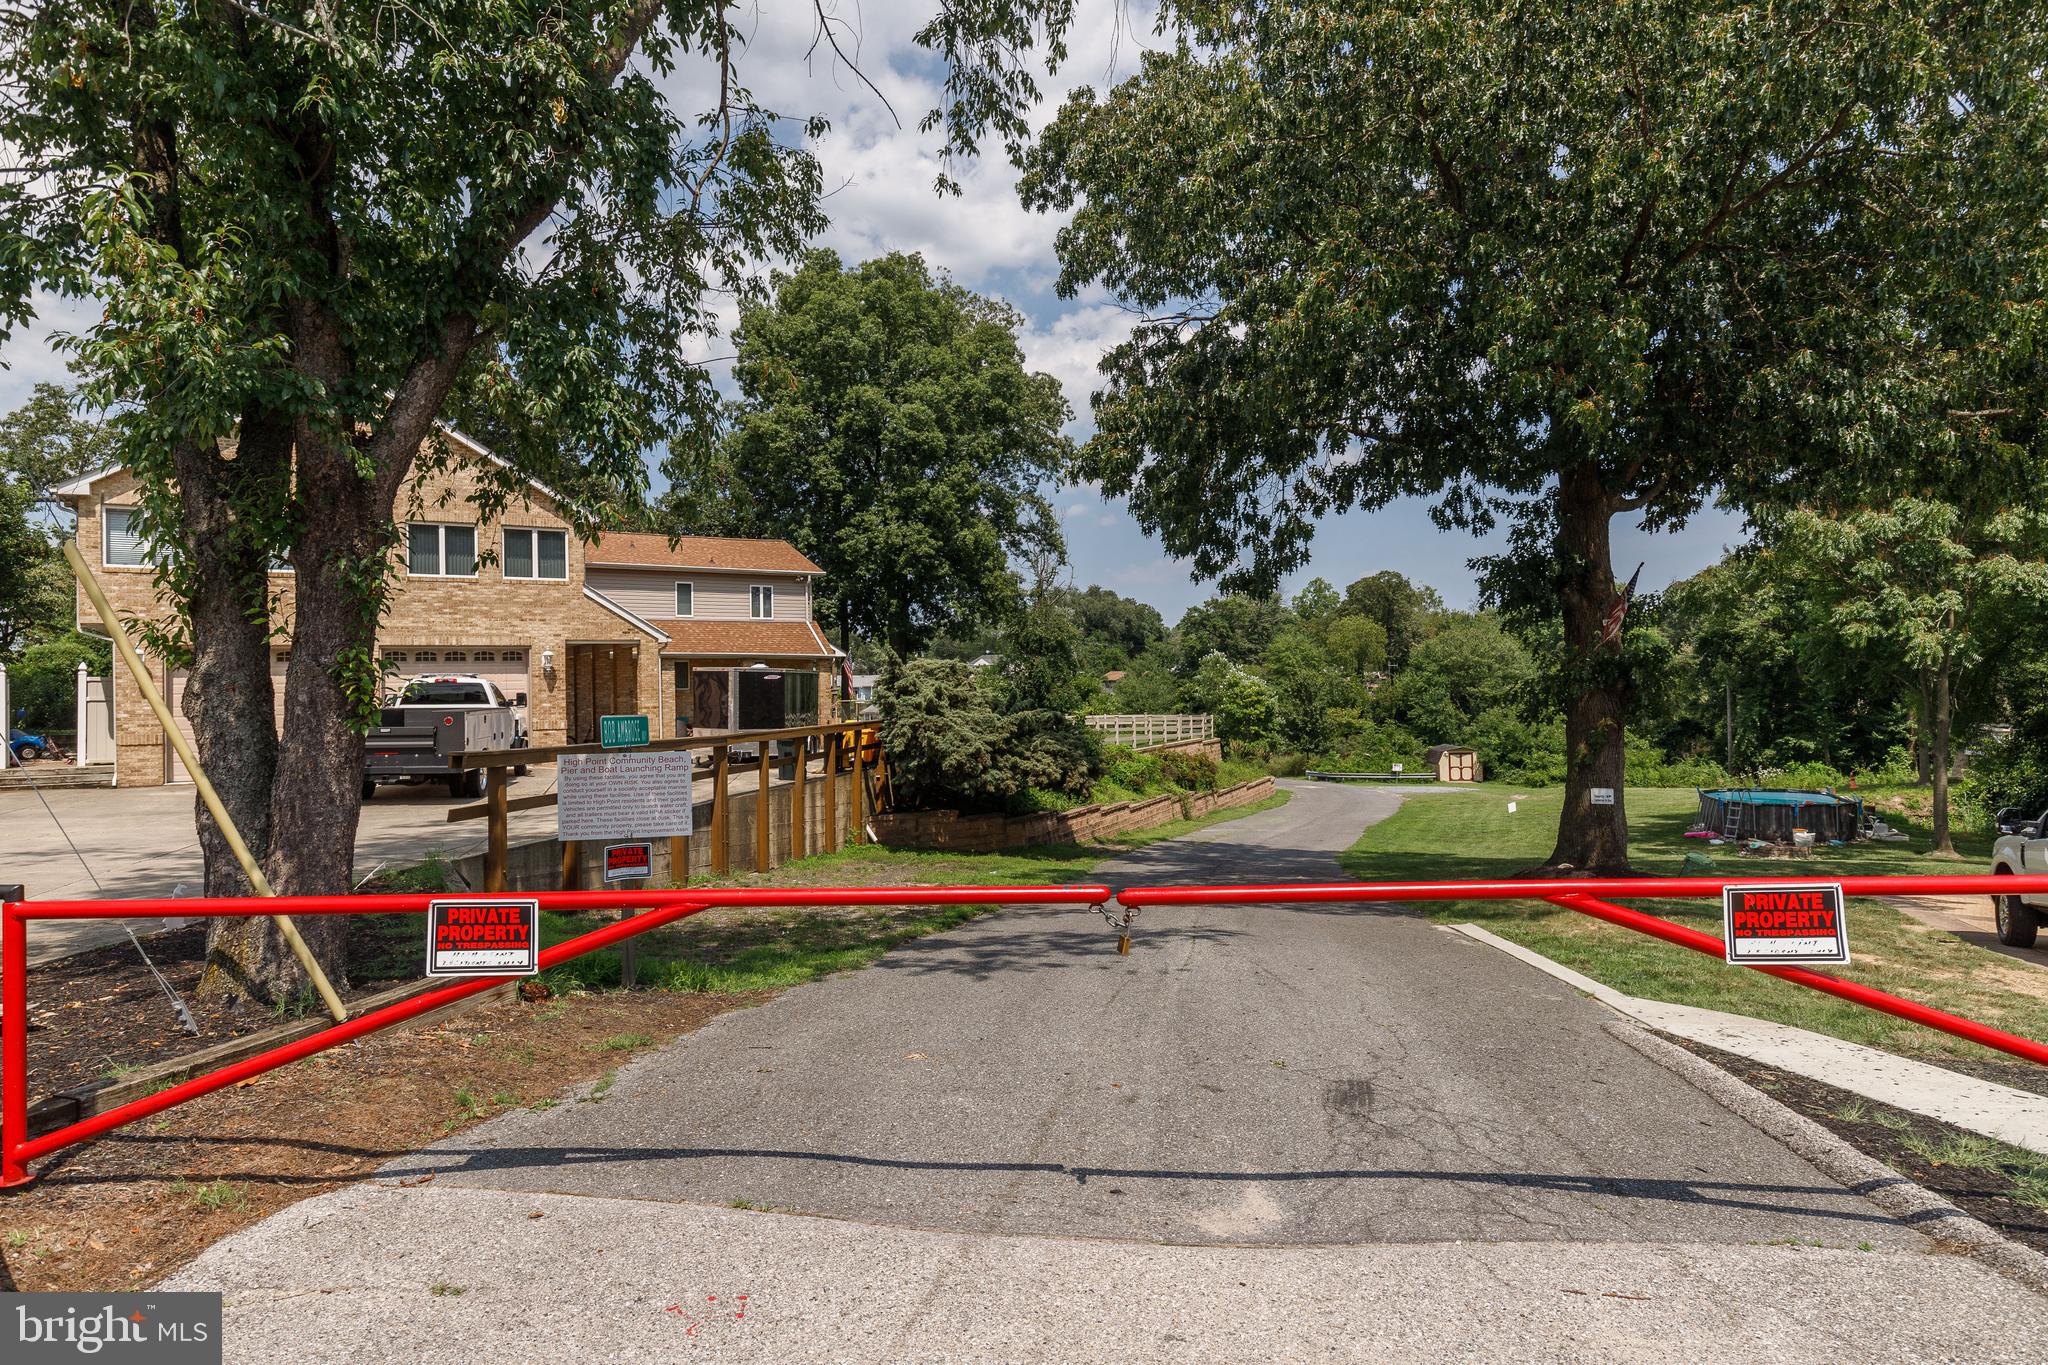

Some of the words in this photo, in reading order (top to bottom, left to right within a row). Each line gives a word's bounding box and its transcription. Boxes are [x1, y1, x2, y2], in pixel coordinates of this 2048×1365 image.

[604, 720, 616, 743] BOB
[618, 720, 640, 742] AMBROSE
[564, 758, 583, 767] High
[610, 757, 655, 766] Community
[620, 764, 661, 773] Launching
[608, 855, 647, 864] PROPERTY
[611, 848, 644, 857] PRIVATE
[1744, 893, 1824, 910] PRIVATE
[448, 908, 521, 924] PRIVATE
[1734, 911, 1834, 928] PROPERTY
[437, 924, 529, 941] PROPERTY
